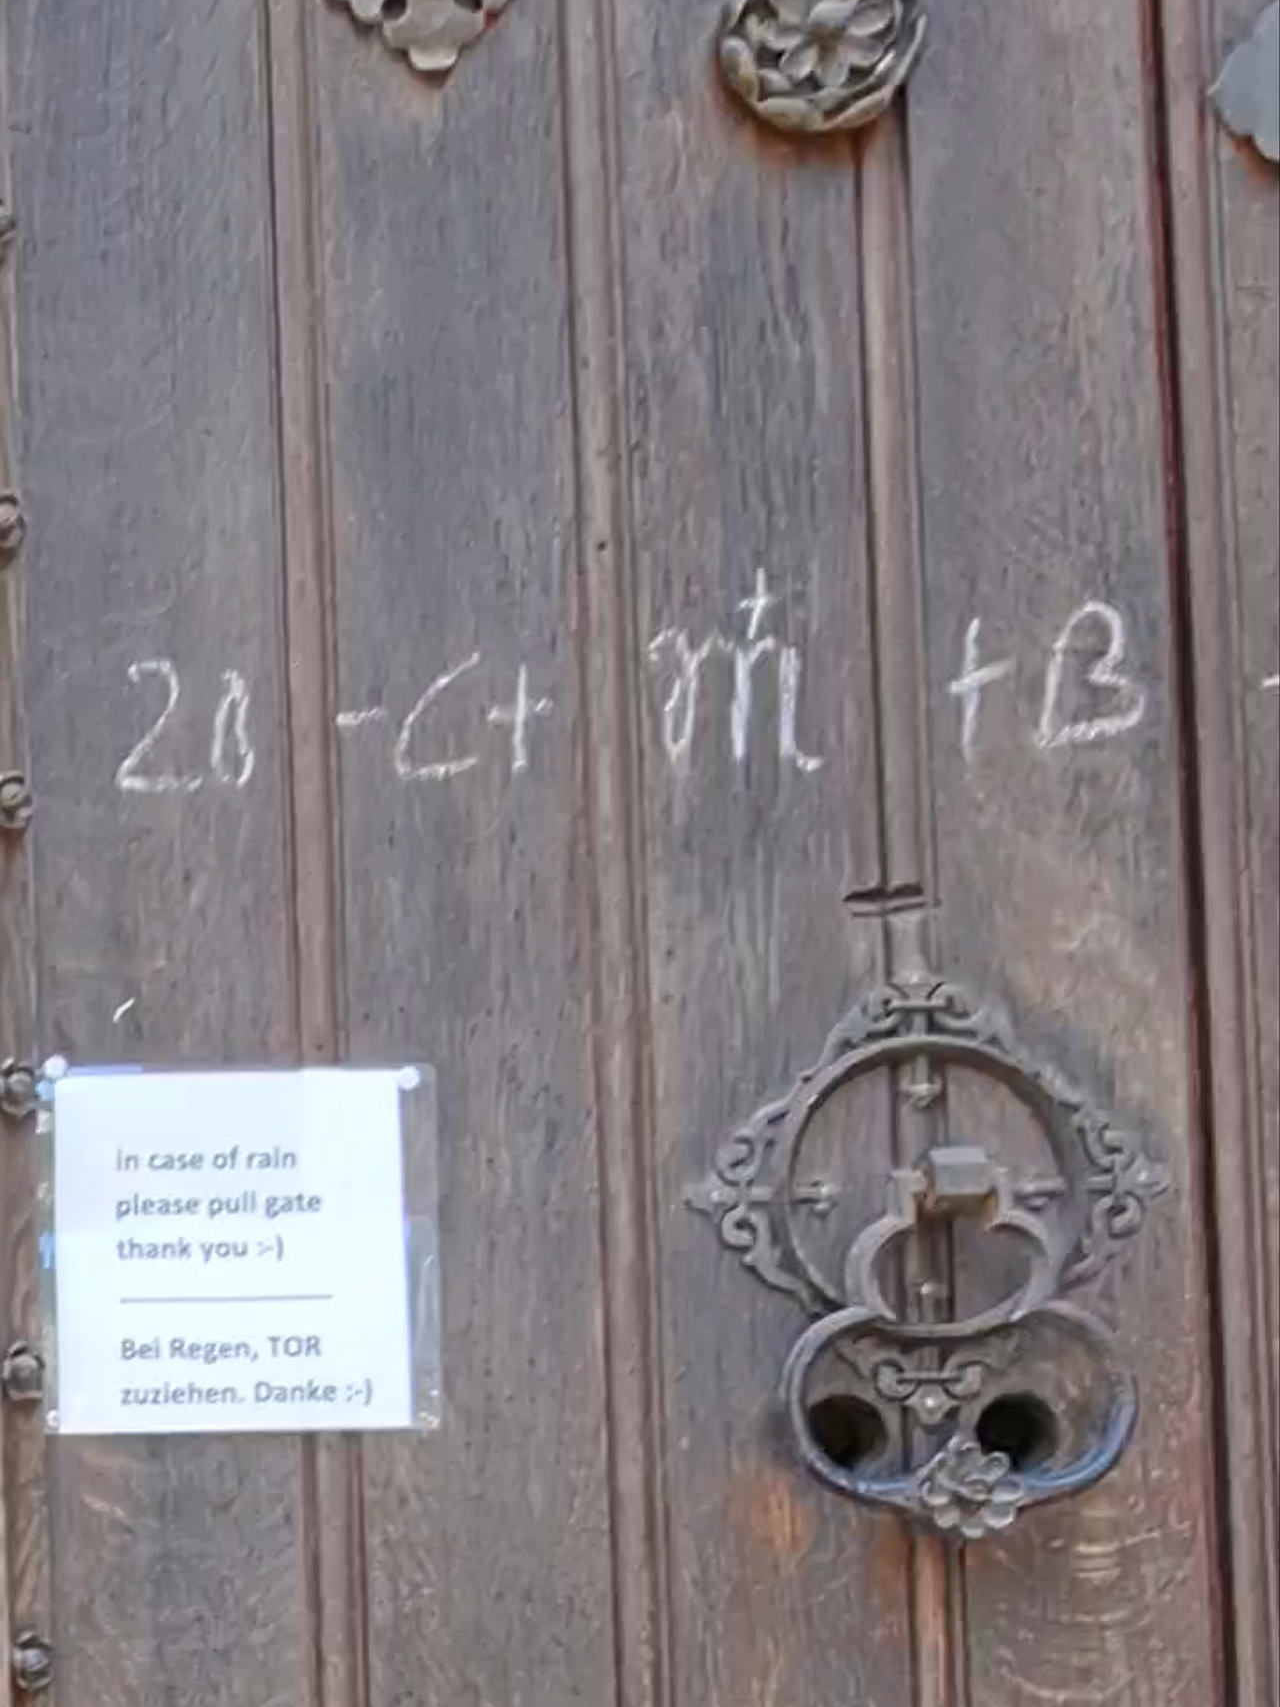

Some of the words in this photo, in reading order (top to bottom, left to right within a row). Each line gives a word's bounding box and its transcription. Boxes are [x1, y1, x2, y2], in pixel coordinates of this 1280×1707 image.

[116, 659, 255, 792] 20
[114, 1146, 140, 1172] in
[147, 1151, 205, 1171] case
[211, 1144, 241, 1170] of
[245, 1146, 298, 1170] rain
[114, 1193, 201, 1221] please
[207, 1190, 257, 1219] pull
[264, 1192, 323, 1219] gate
[115, 1236, 192, 1261] thank
[198, 1240, 248, 1264] you
[120, 1335, 161, 1360] Bei
[168, 1336, 260, 1365] Regen,
[267, 1334, 323, 1358] TOR
[120, 1380, 247, 1406] zuziehen.
[253, 1379, 339, 1405] Danke
